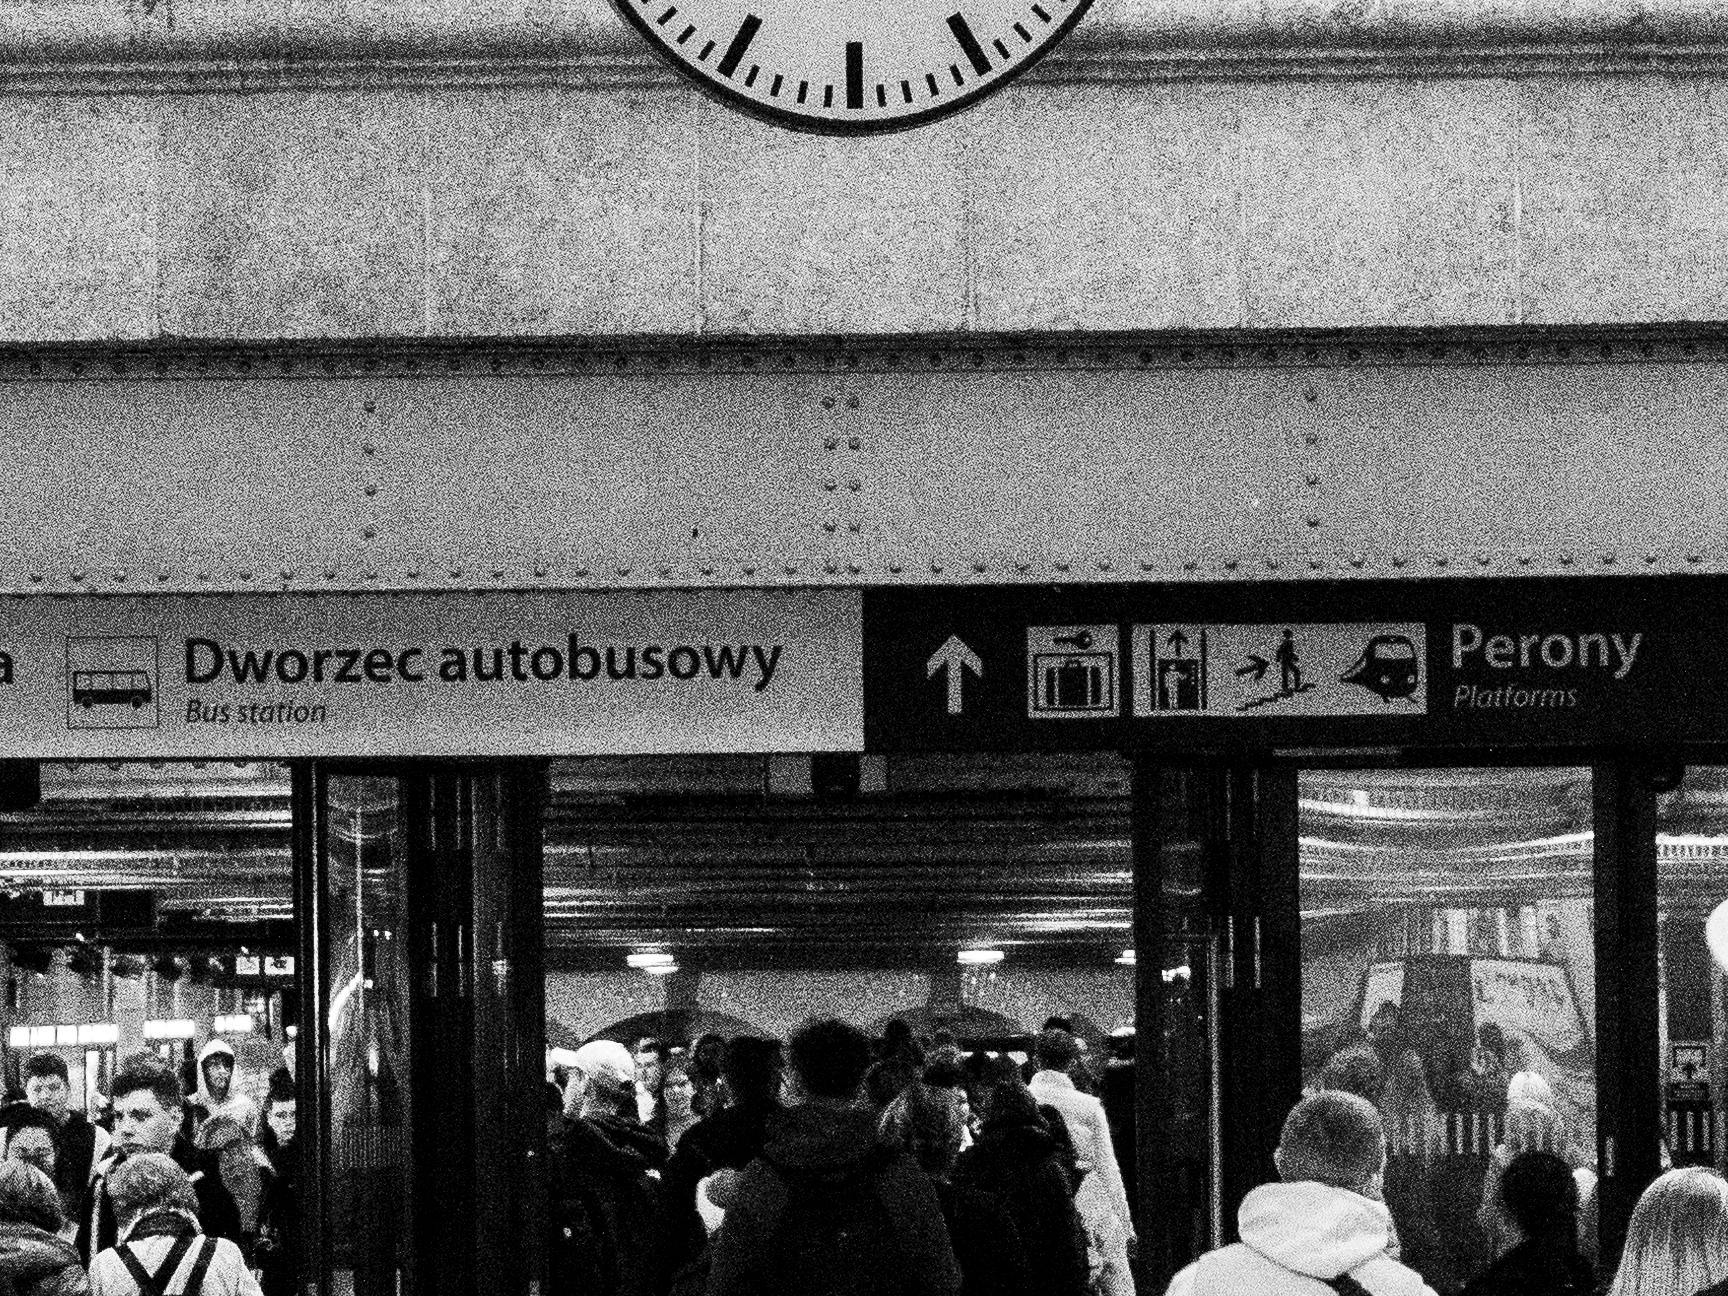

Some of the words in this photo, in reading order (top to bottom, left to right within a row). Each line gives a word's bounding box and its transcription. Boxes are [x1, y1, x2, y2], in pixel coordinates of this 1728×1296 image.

[184, 637, 422, 684] Dworzec
[439, 633, 783, 692] autobusowy
[1452, 623, 1642, 679] Perony
[184, 698, 230, 724] Bus
[238, 698, 327, 724] station
[1452, 680, 1579, 709] Platforms
